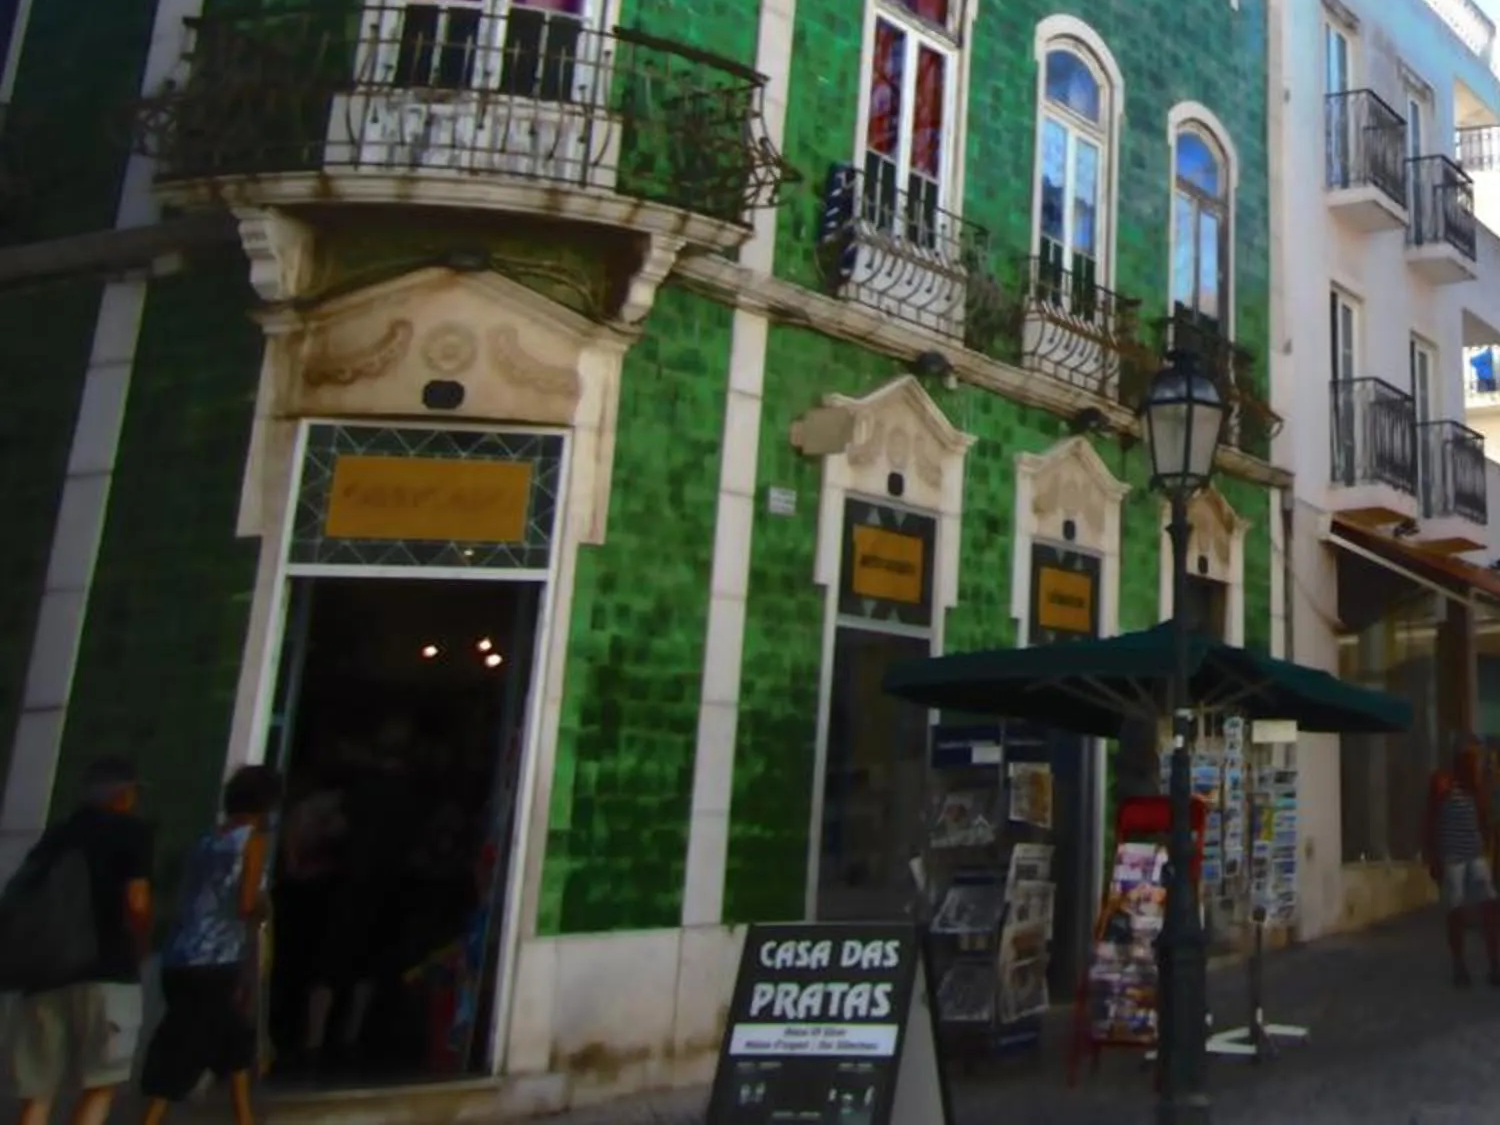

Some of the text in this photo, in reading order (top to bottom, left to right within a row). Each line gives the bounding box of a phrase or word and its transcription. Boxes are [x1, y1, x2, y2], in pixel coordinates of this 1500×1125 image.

[760, 939, 900, 969] CASA DAS
[750, 982, 893, 1020] PRATAS
